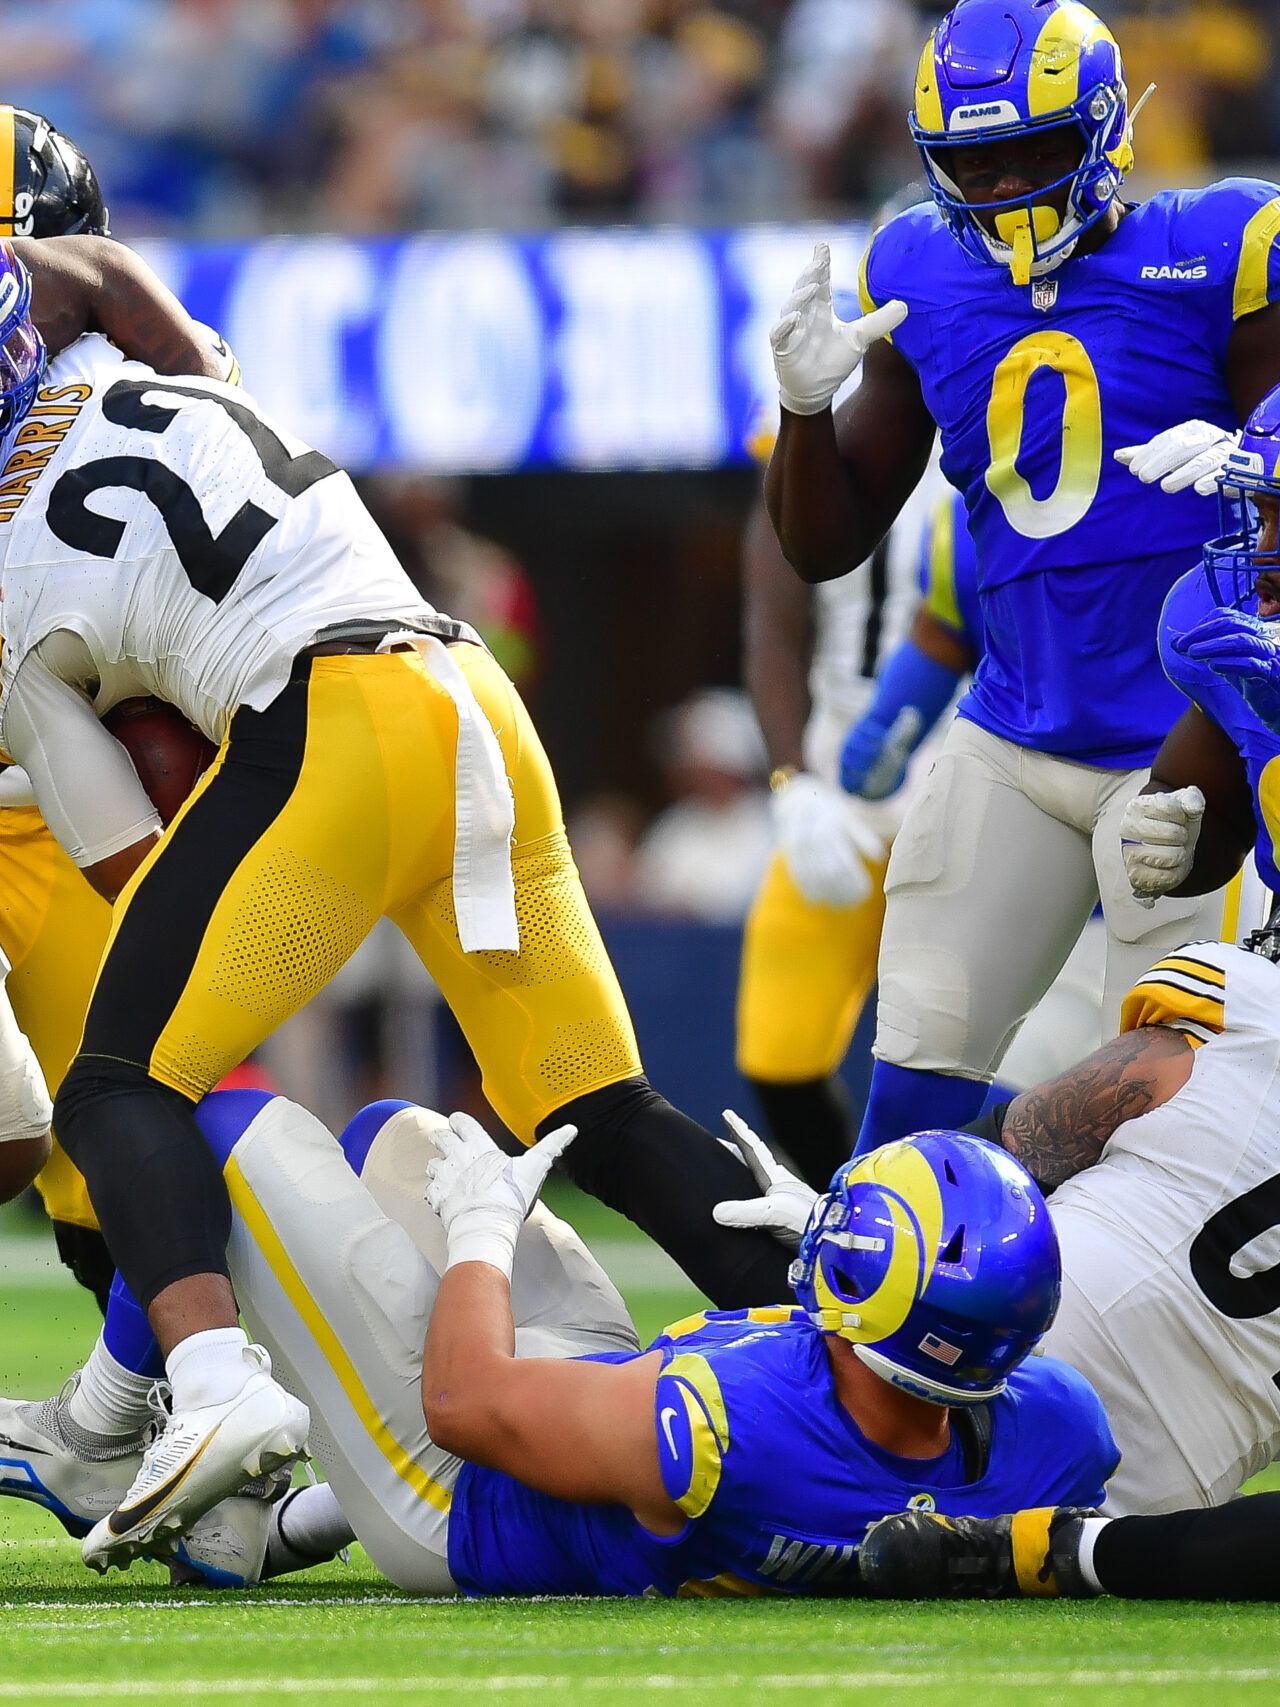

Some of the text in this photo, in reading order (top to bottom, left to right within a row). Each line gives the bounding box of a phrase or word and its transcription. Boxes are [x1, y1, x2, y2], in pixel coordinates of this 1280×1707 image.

[959, 105, 1002, 119] RAMS
[1140, 265, 1208, 280] RAMS
[984, 329, 1103, 539] 0
[45, 379, 342, 607] 22
